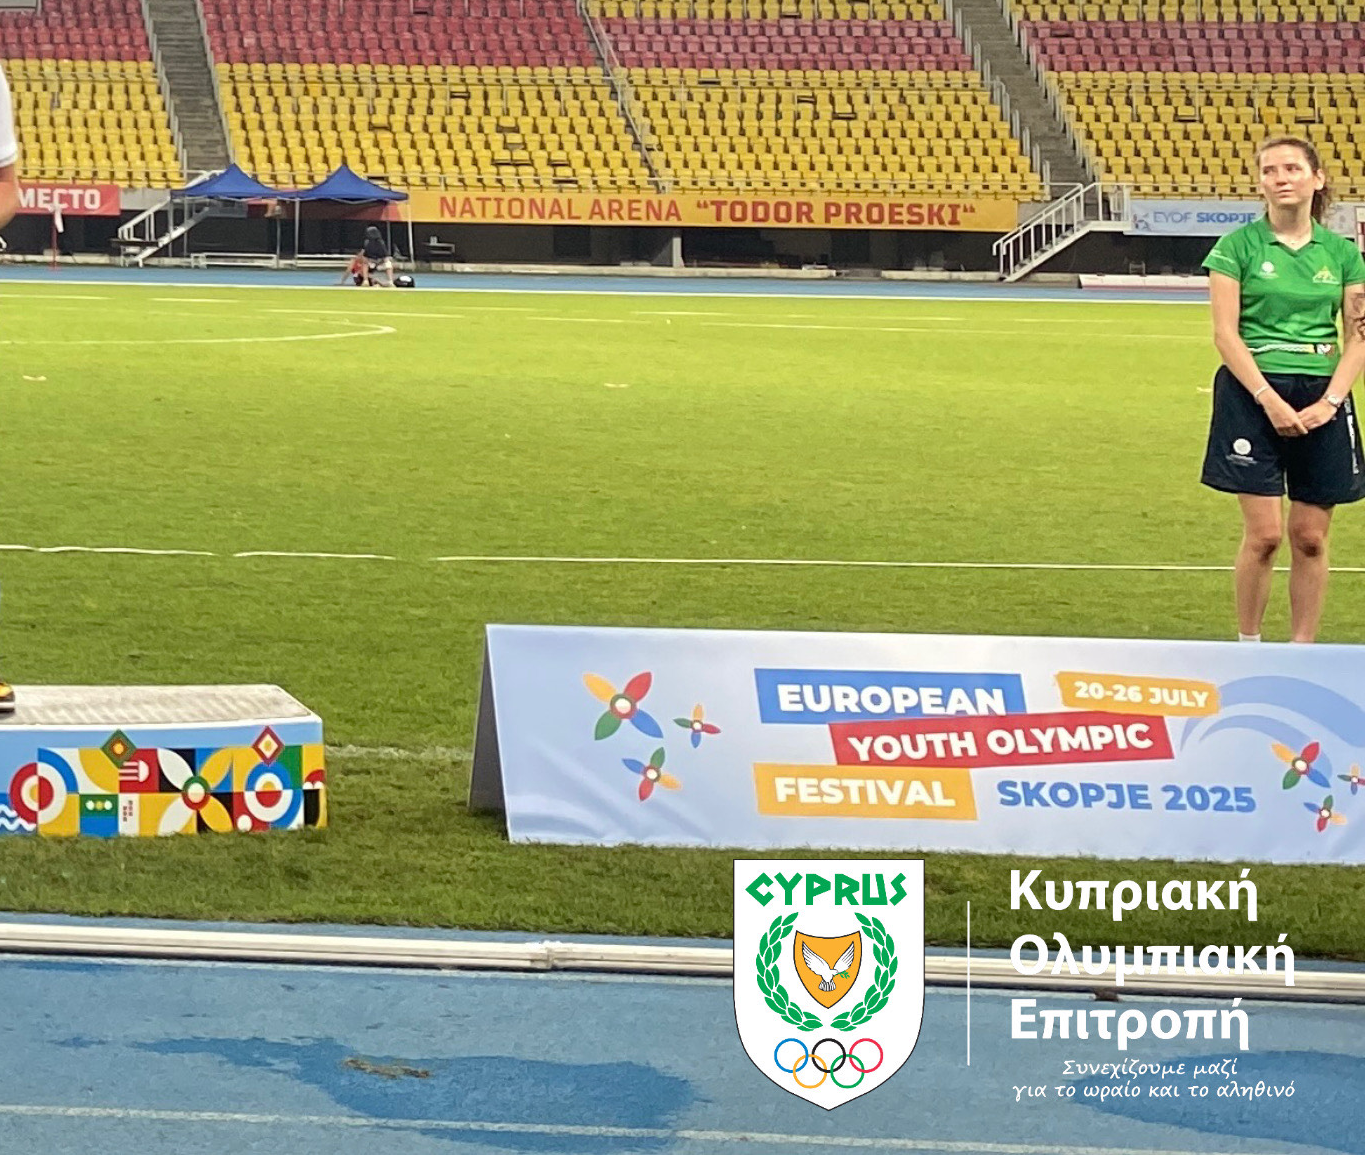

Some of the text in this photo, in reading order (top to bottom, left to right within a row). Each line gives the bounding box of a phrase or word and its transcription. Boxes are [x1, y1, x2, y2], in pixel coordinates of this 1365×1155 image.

[439, 196, 581, 220] NATIONAL
[588, 198, 682, 221] ARENA
[1153, 211, 1192, 223] EYOF
[777, 684, 1007, 716] EUROPEAN
[1074, 681, 1209, 708] 20-26 JULY
[847, 723, 1153, 762] YOUTH OLYMPIC
[774, 777, 956, 807] FESTIVAL
[997, 780, 1257, 813] SKOPJE 2025
